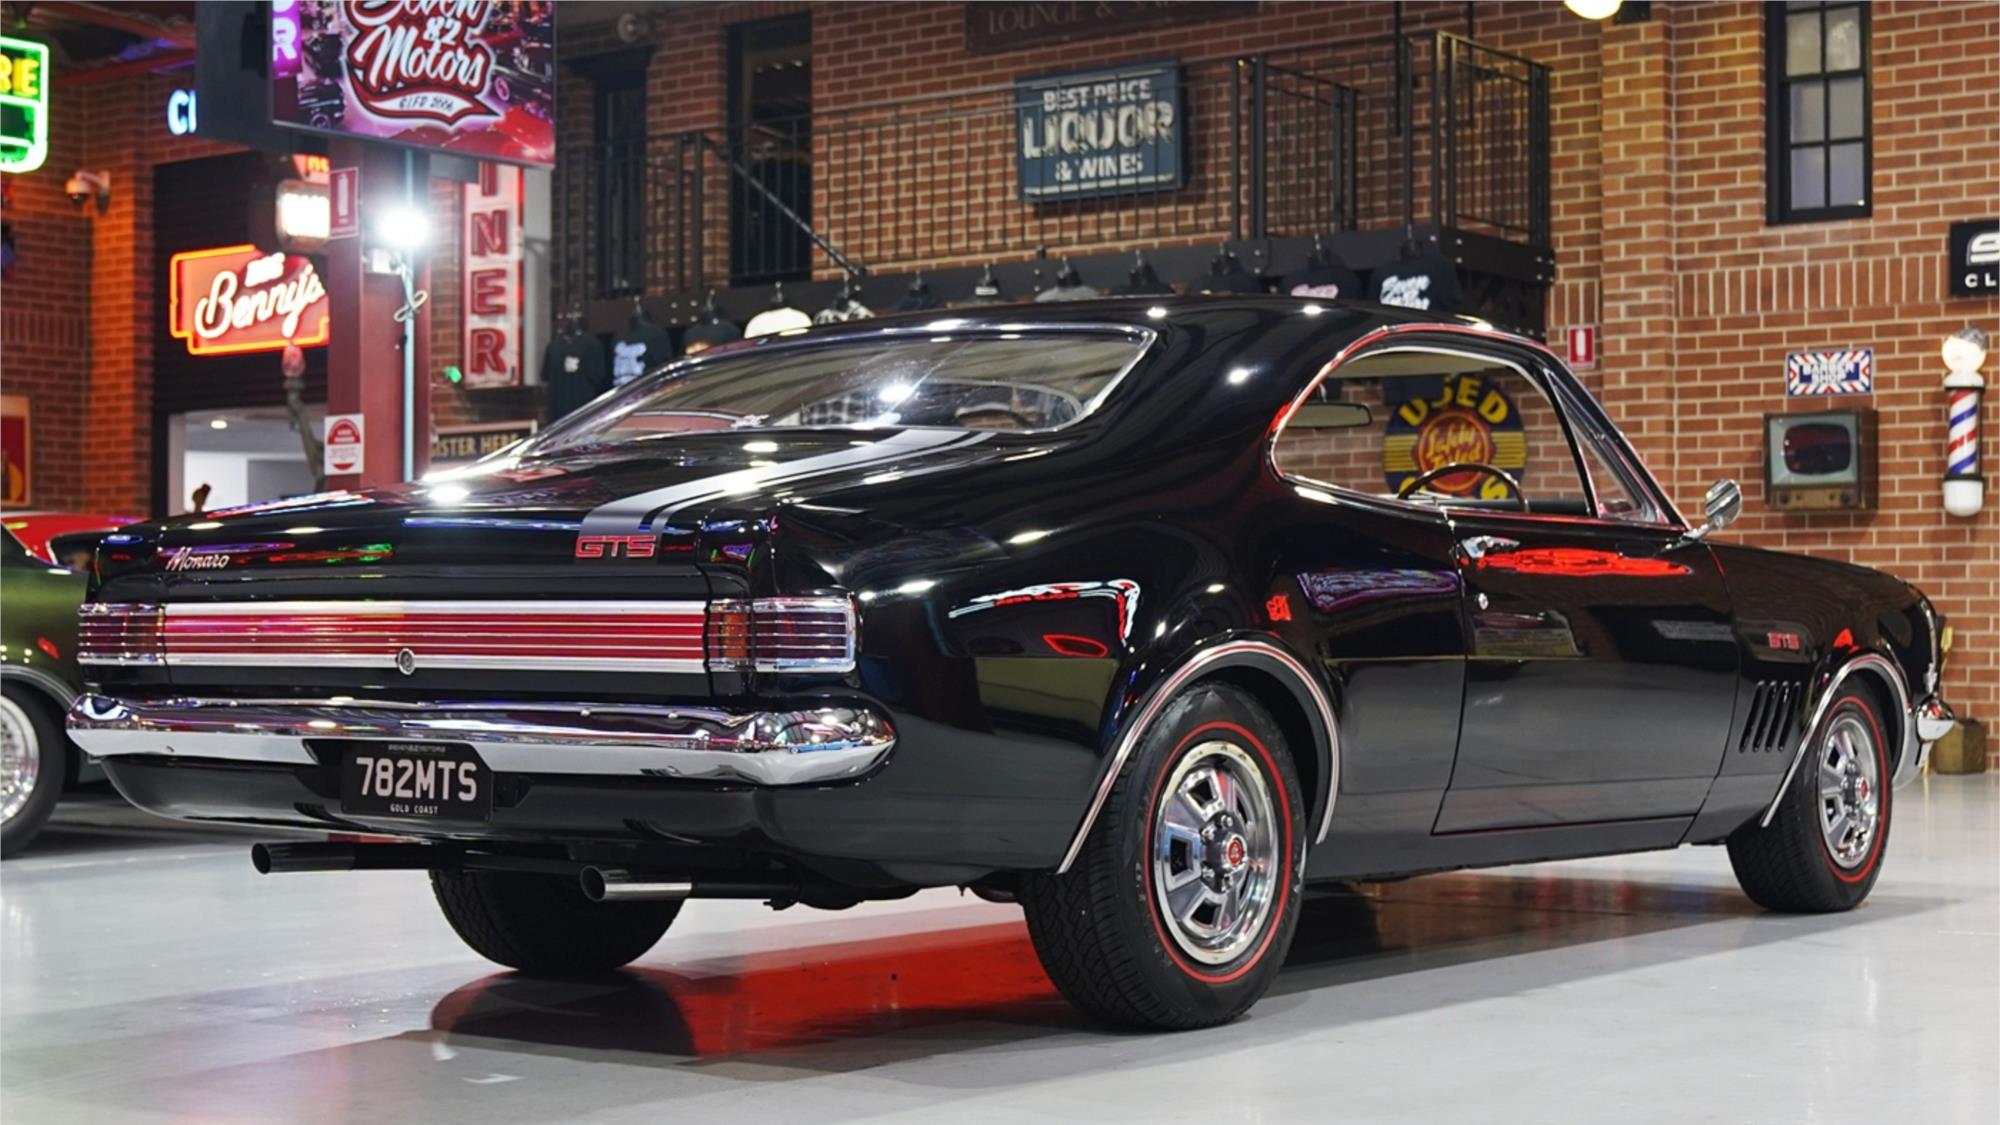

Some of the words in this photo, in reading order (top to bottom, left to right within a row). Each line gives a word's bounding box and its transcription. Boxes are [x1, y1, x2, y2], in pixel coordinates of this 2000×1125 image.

[422, 16, 462, 45] 82
[353, 24, 484, 88] Motors
[1043, 86, 1090, 112] BEST
[1093, 78, 1151, 104] PRICE
[1023, 101, 1173, 159] LIQUOR
[1054, 160, 1073, 182] &
[1075, 153, 1143, 179] WINES
[195, 264, 326, 338] Benny's
[1802, 360, 1855, 375] BARBER
[1811, 370, 1847, 384] SHOP
[165, 546, 230, 571] Monaro
[576, 535, 657, 557] GTS
[356, 757, 477, 801] 782MTS
[390, 804, 409, 813] GOLD
[414, 805, 438, 815] COAST
